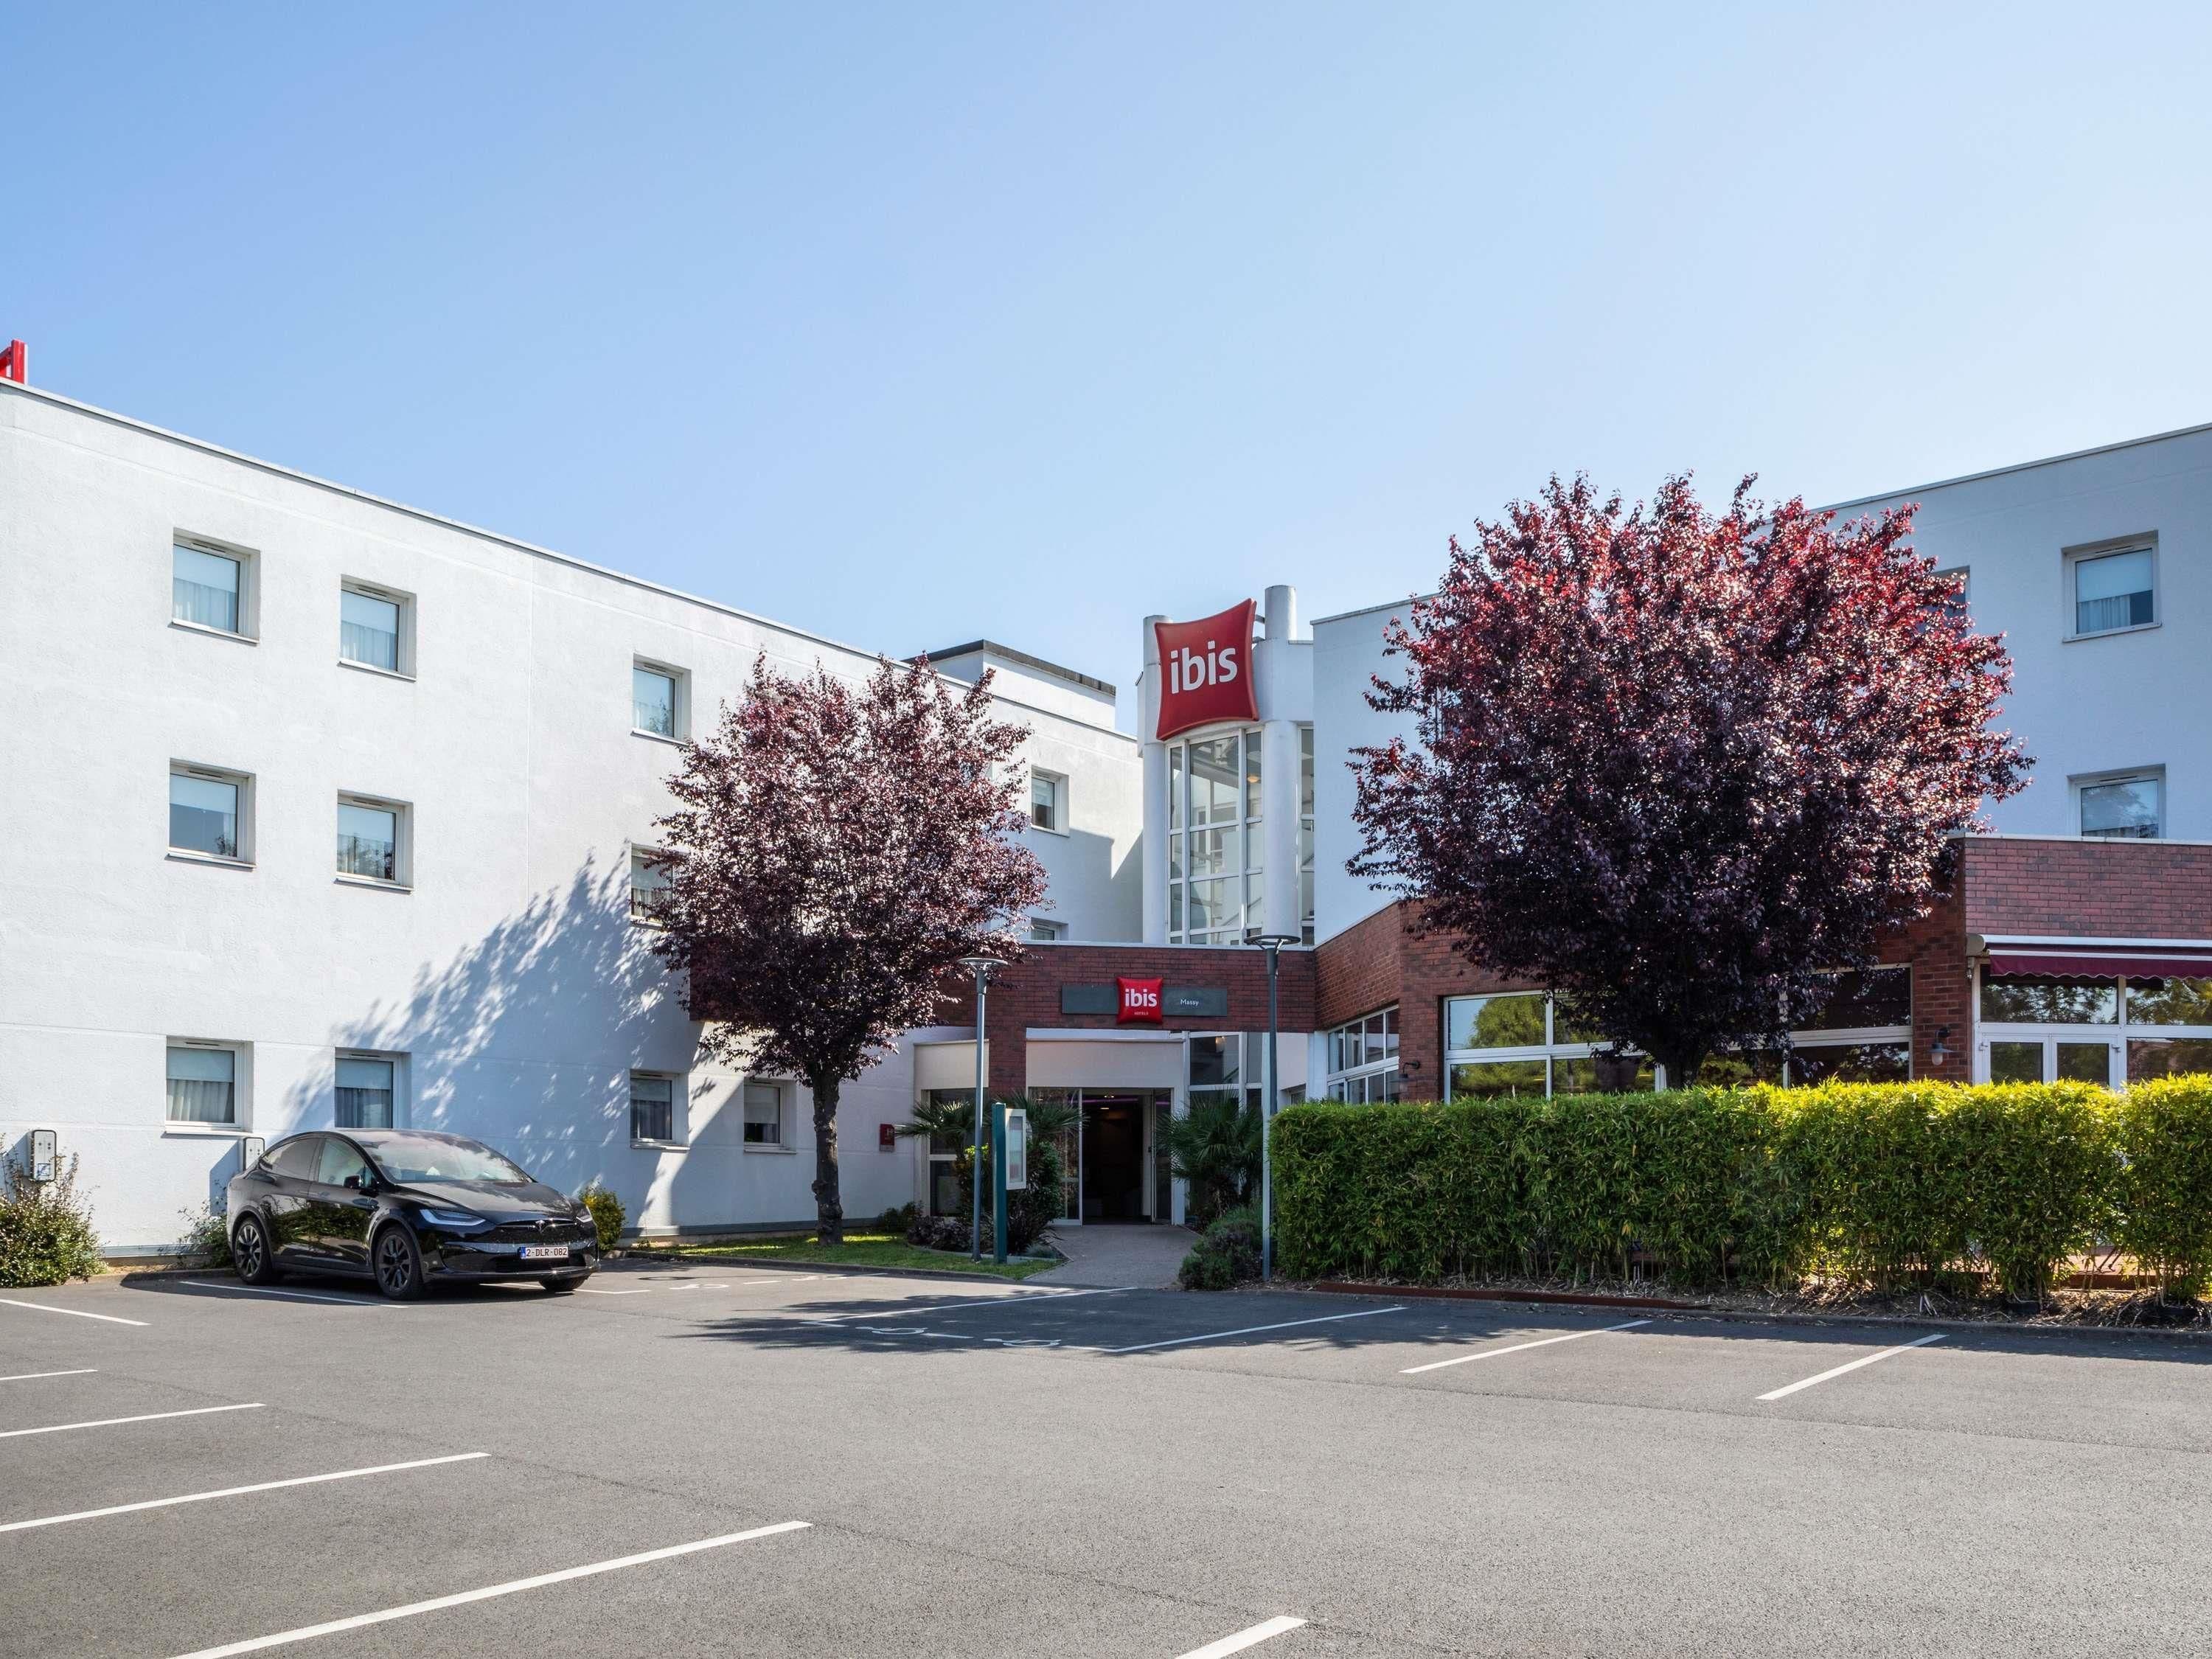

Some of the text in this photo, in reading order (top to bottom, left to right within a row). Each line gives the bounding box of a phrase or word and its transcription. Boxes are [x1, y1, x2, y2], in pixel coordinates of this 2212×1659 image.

[1170, 640, 1238, 695] ibis
[1125, 988, 1157, 1007] ibis
[1180, 998, 1199, 1007] Massy
[526, 1248, 567, 1257] 2-DLR-082
